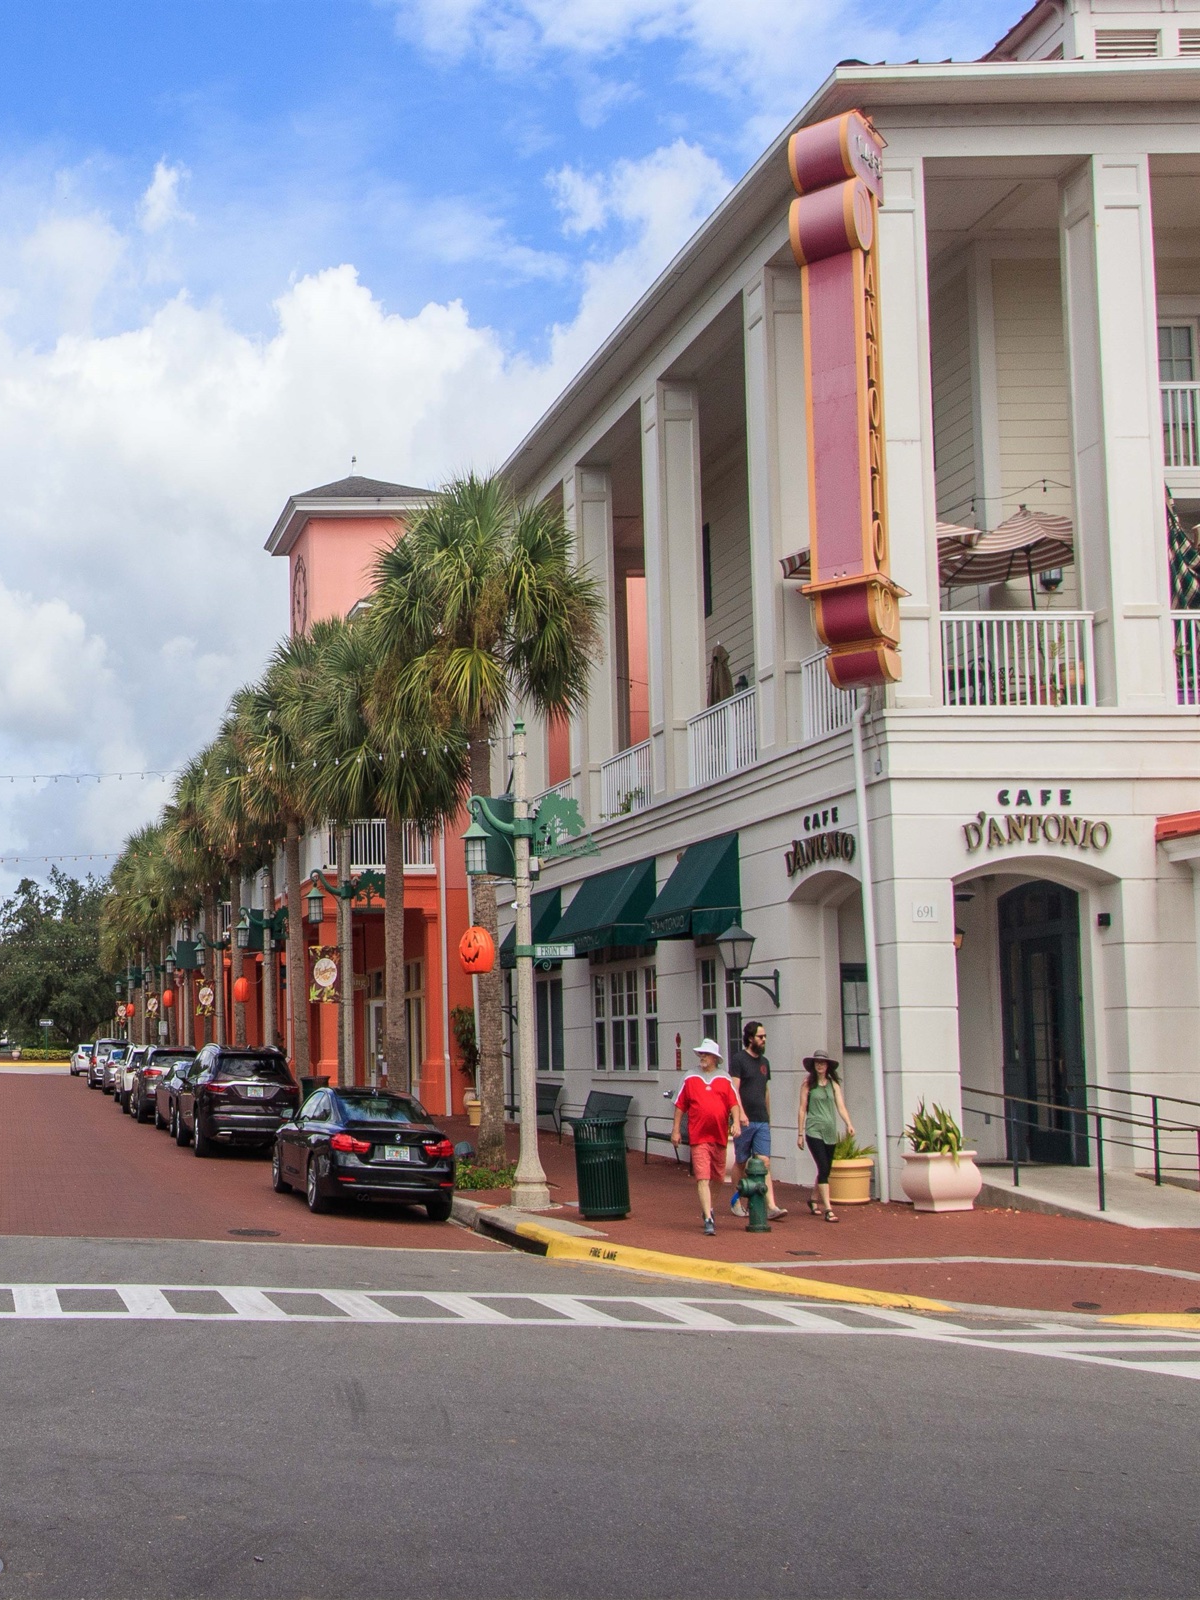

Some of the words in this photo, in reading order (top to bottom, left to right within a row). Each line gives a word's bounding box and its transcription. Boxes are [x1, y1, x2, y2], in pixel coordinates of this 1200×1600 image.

[997, 789, 1072, 806] CAFE
[803, 806, 839, 831] CAFE
[962, 811, 1112, 851] D'ANTONIO
[784, 831, 856, 877] D'ANTONIO
[917, 905, 933, 918] 691
[541, 946, 560, 956] FRONT
[589, 1247, 602, 1258] FIRE
[603, 1249, 618, 1261] LANE
